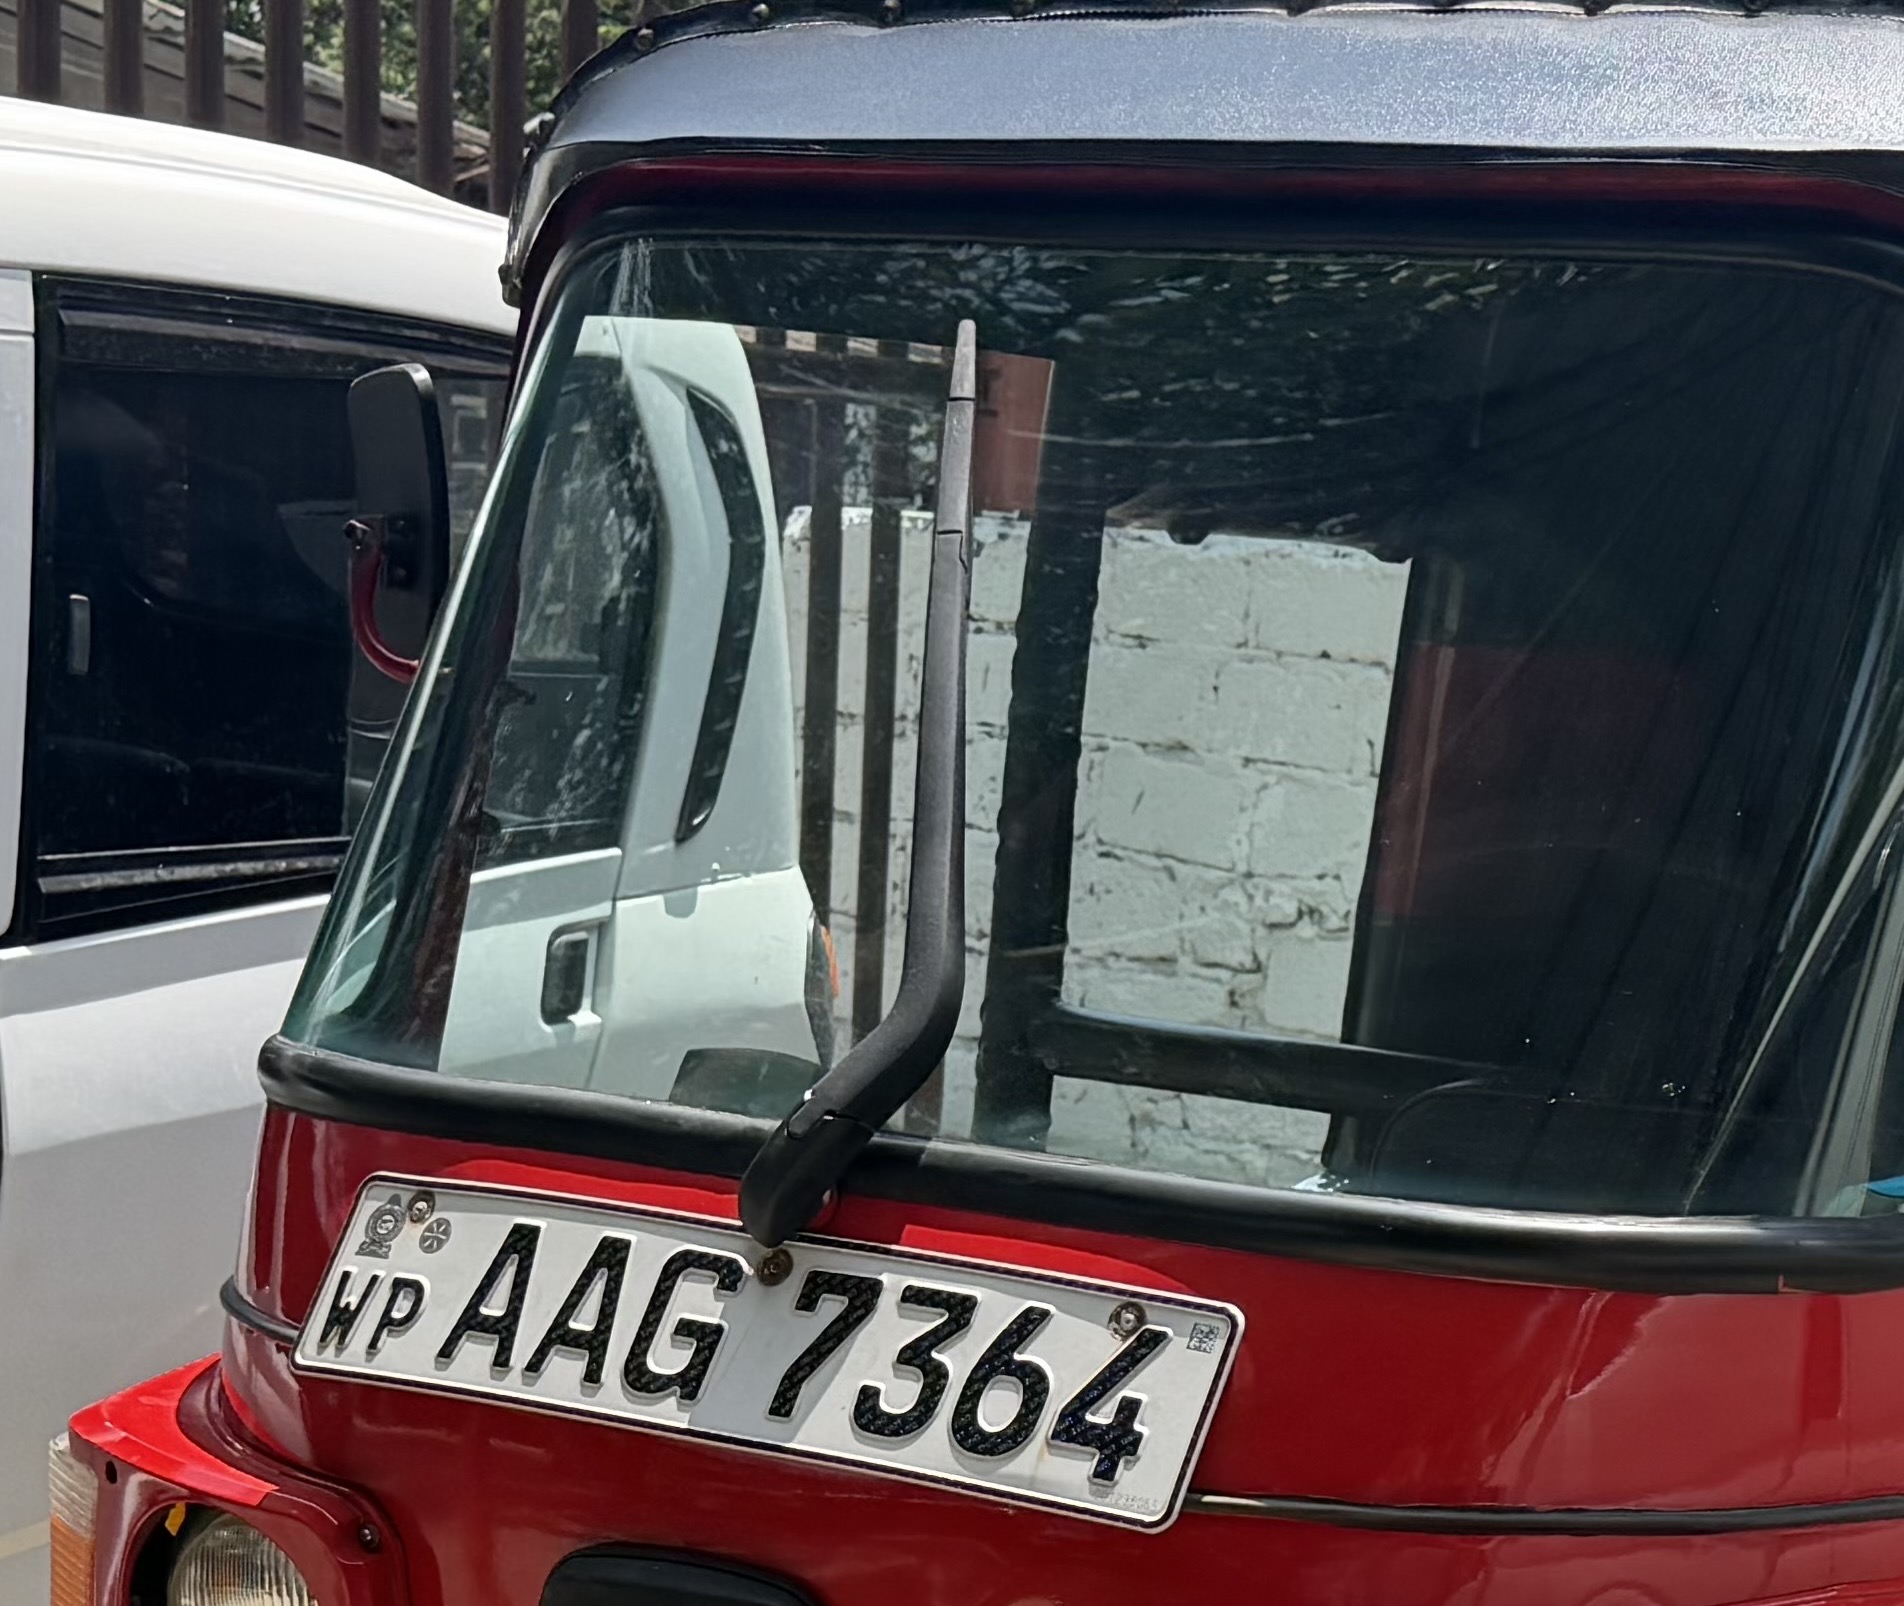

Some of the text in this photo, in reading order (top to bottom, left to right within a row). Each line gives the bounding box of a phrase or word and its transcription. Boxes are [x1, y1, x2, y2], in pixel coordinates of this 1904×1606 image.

[318, 1222, 1171, 1484] WP AAG 7364
